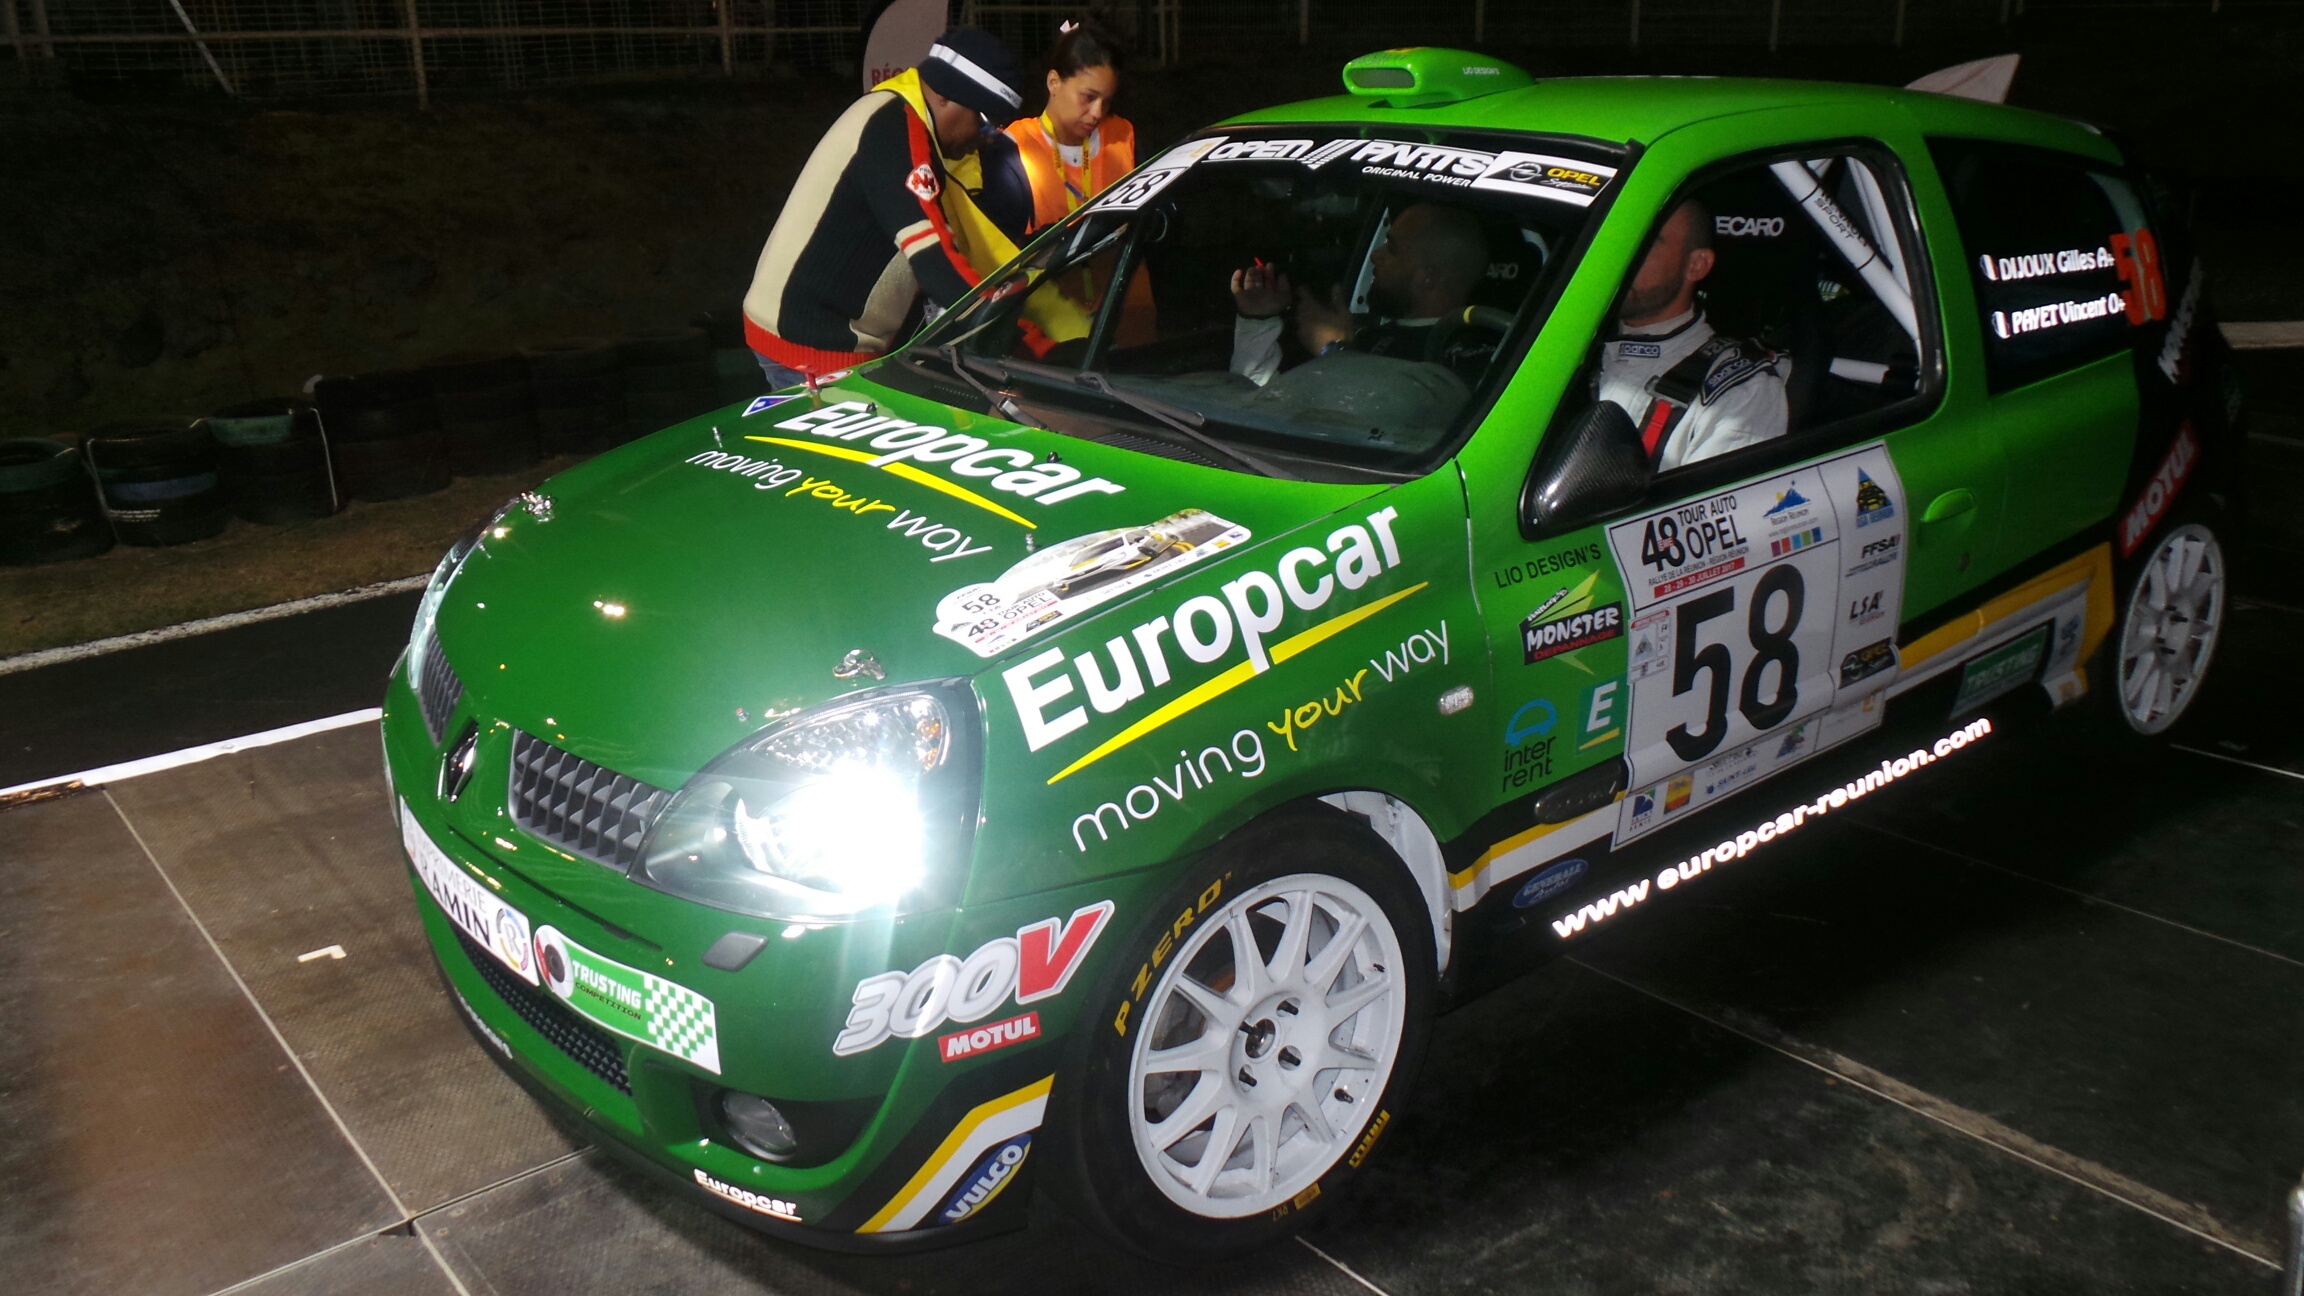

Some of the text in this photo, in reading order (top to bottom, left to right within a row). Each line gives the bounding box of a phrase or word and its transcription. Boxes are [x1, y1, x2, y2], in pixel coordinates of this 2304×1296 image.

[871, 62, 904, 86] RÉ
[1350, 141, 1497, 176] PARTS
[1361, 164, 1471, 188] ORIGINAL POWER
[1546, 167, 1602, 187] OPEL
[1101, 170, 1171, 206] 58
[1715, 215, 1785, 238] ECARO
[1814, 197, 1854, 239] SPORT
[1999, 252, 2057, 281] DIJOUX
[2056, 249, 2096, 273] Gilles
[2109, 228, 2167, 327] 58
[2011, 303, 2059, 334] PAYET
[2058, 296, 2108, 324] Vincent
[1620, 344, 1660, 356] sparco
[1708, 358, 1750, 387] sparco
[773, 400, 1127, 506] Europcar
[684, 449, 993, 563] moving your way
[1677, 494, 1738, 527] TOUR AUTO
[1641, 516, 1686, 572] 48
[1685, 514, 1748, 559] OPEL
[1861, 535, 1897, 559] FFSA
[1494, 543, 1602, 588] LIO DESIGN'S
[1648, 572, 1668, 587] RALLYE
[1697, 568, 1721, 583] JUILLET
[961, 593, 1002, 614] 58
[1003, 596, 1054, 620] OPEL
[1022, 591, 1046, 605] AUTO
[1002, 505, 1402, 753] Europcar
[1526, 606, 1620, 652] MONSTER
[1665, 563, 1805, 763] 58
[1586, 681, 1618, 732] E
[1072, 620, 1450, 852] moving your way
[1503, 735, 1557, 773] inter
[1502, 756, 1553, 793] rent
[1551, 716, 1993, 939] www europcar-reunion.com
[832, 899, 1116, 1057] 300V
[1113, 878, 1223, 1038] P ZERO
[572, 958, 643, 1011] TRUSTING
[574, 980, 643, 1021] COMPETITION
[946, 1016, 1037, 1058] MOTUL
[694, 1168, 797, 1217] Europcar
[945, 1143, 1026, 1220] VULCO
